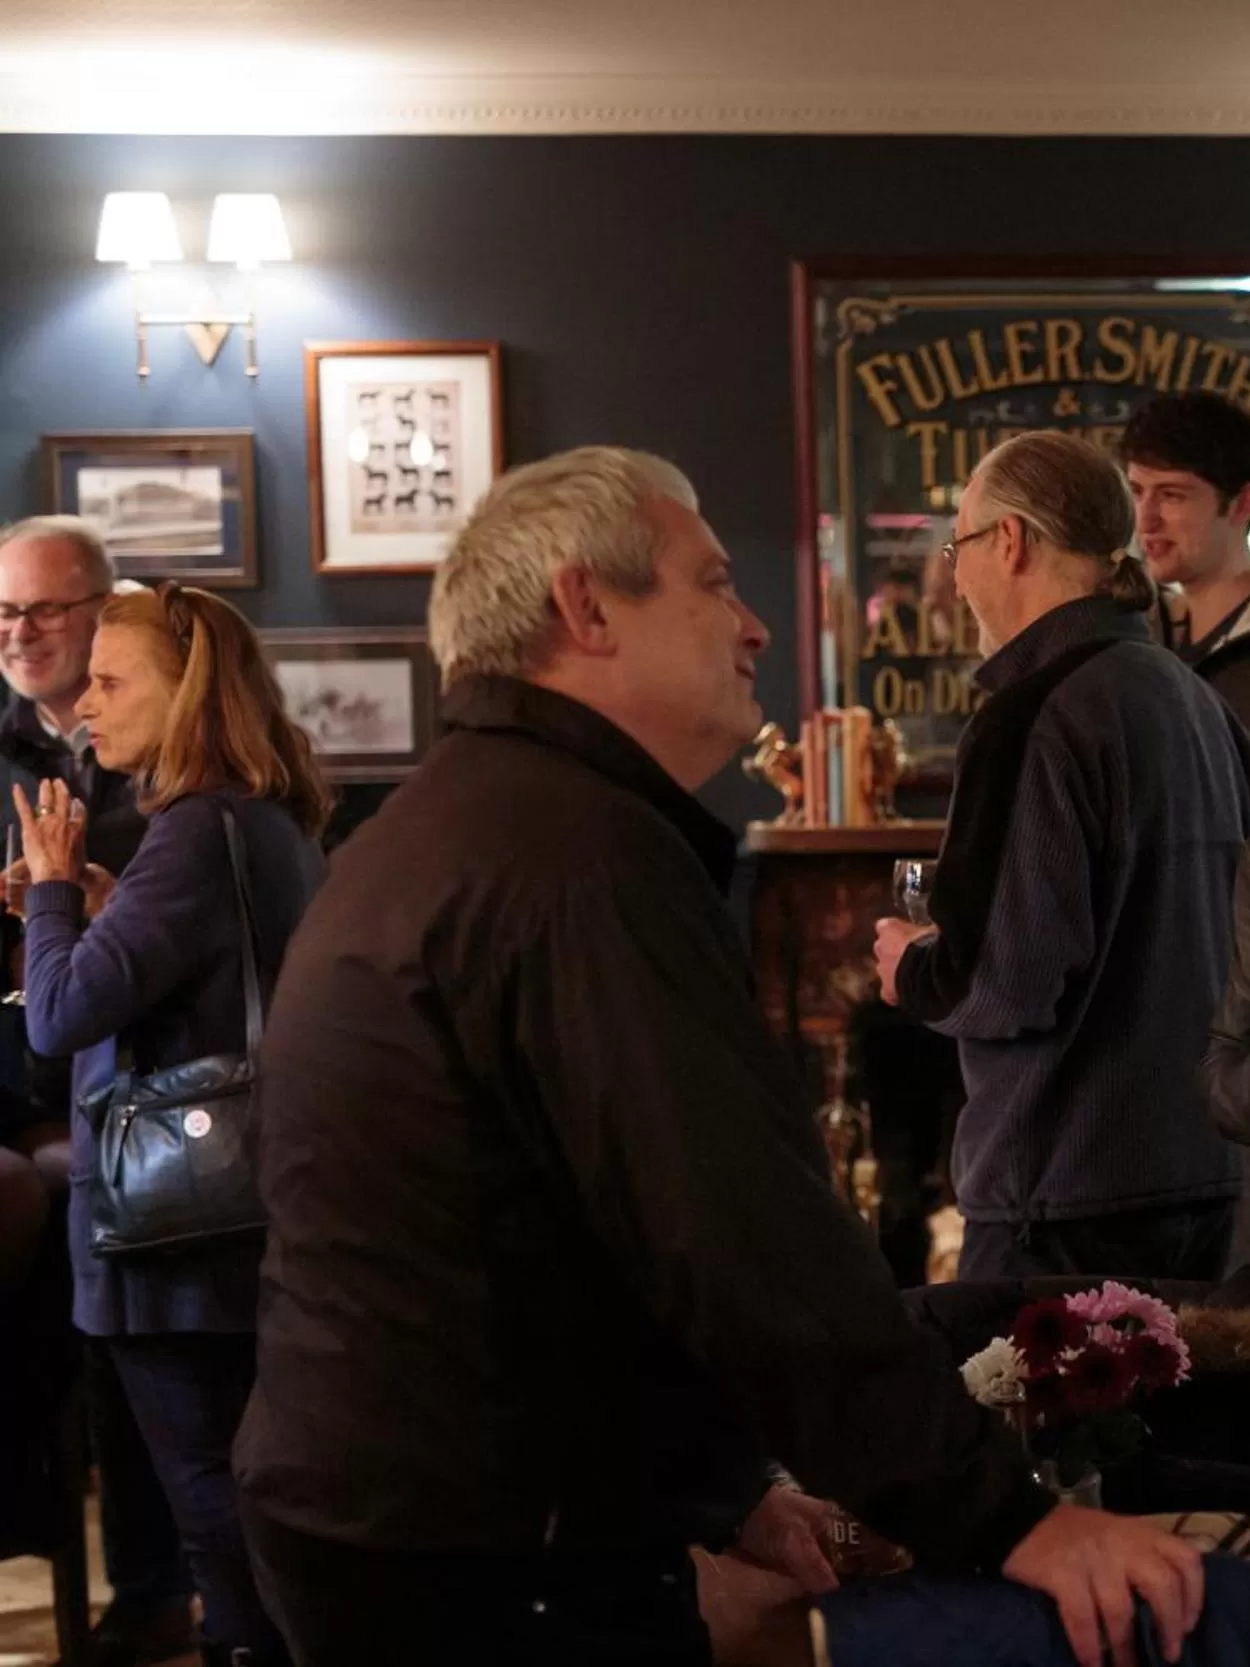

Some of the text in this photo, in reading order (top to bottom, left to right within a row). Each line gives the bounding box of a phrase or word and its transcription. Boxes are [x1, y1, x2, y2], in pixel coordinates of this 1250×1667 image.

[856, 318, 1084, 427] FULLER
[1052, 388, 1081, 416] &
[861, 600, 981, 659] ALE
[873, 666, 926, 716] On
